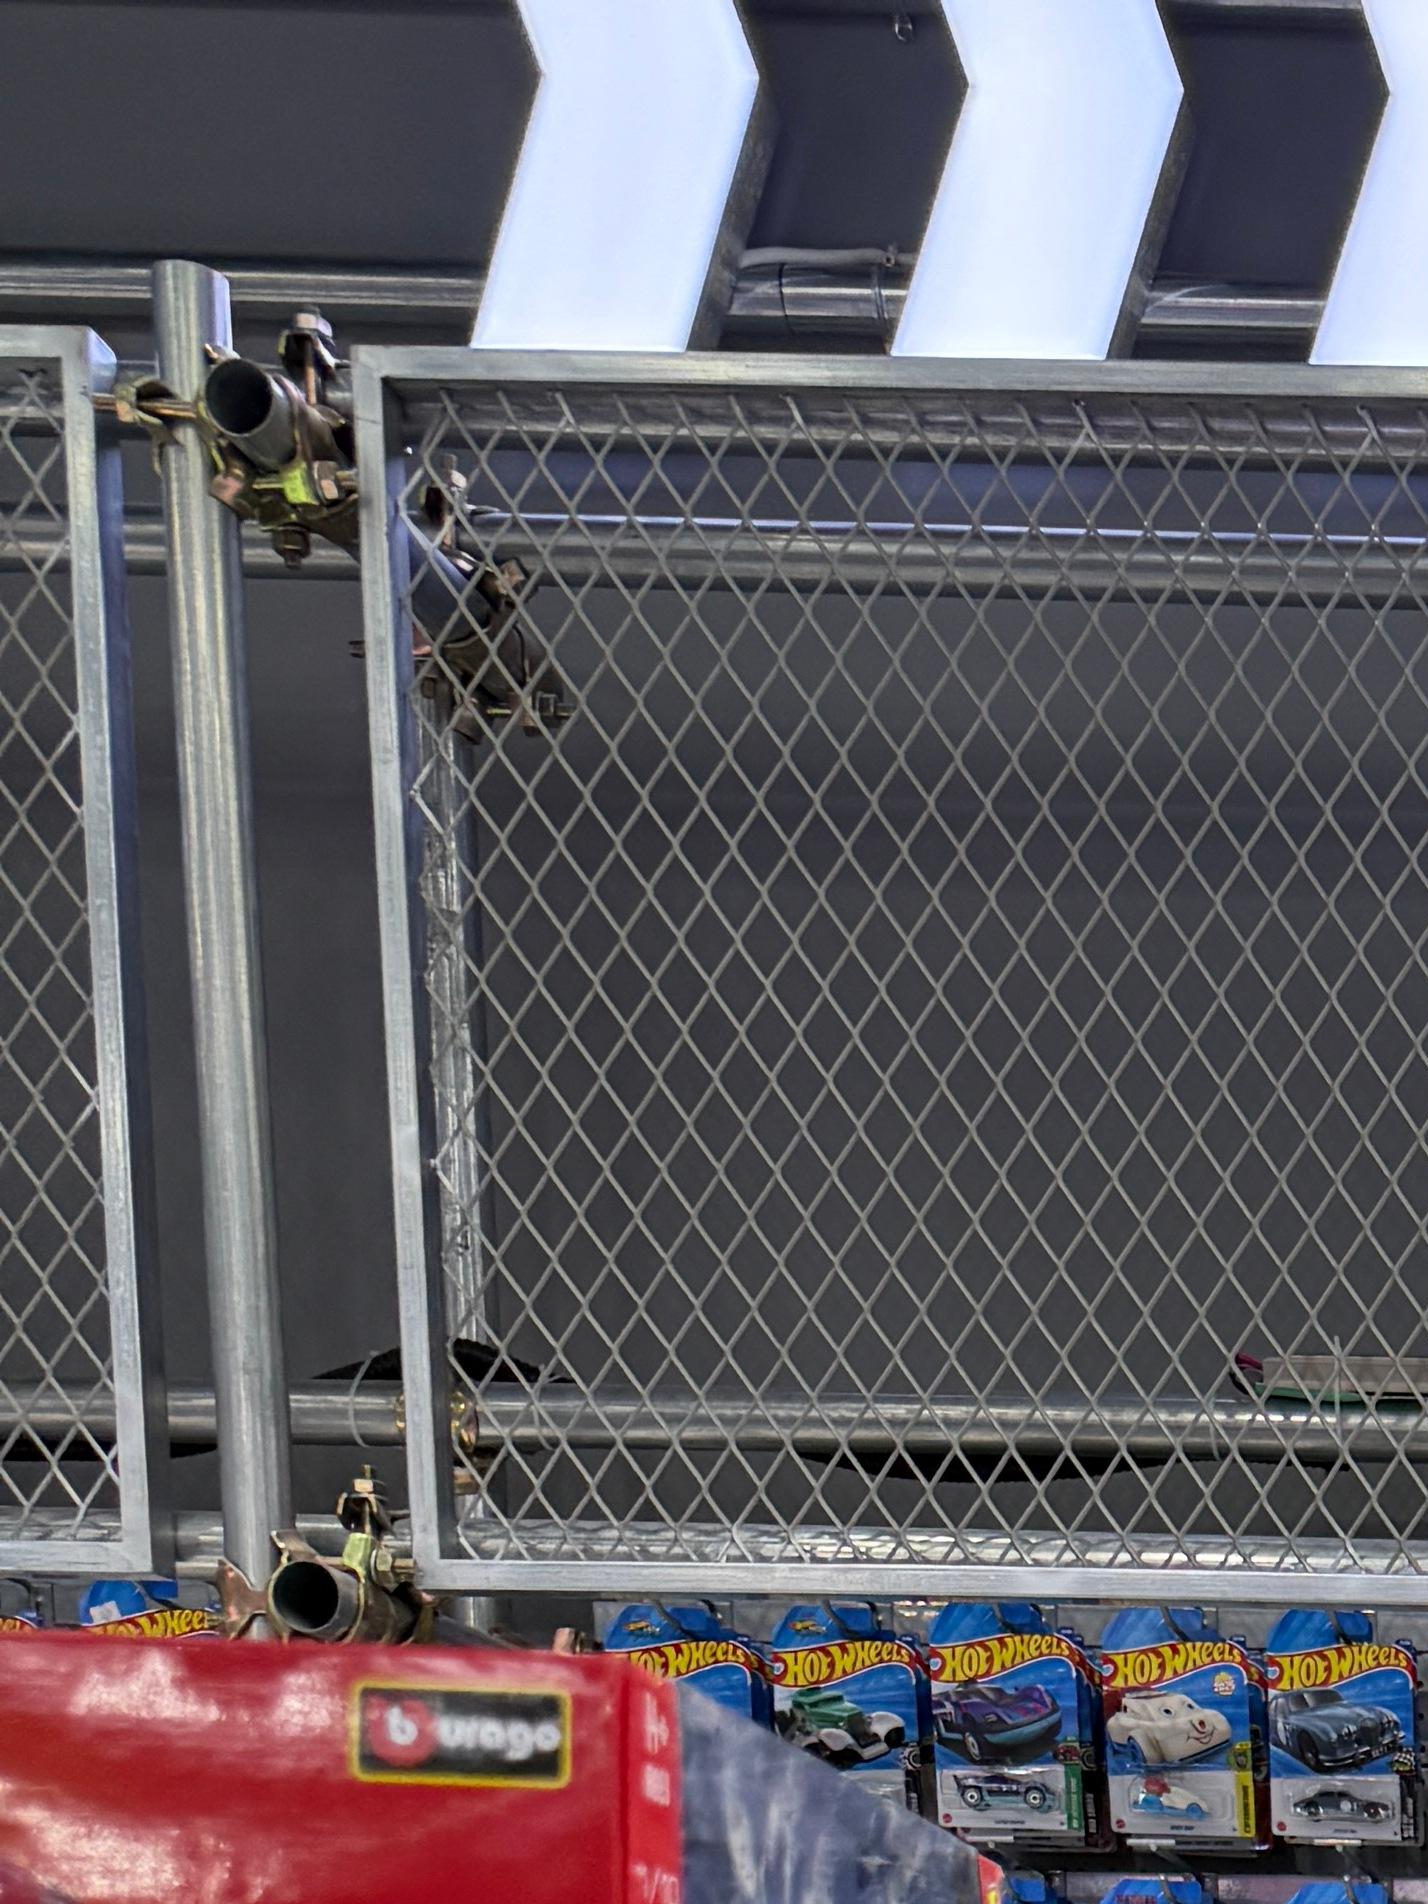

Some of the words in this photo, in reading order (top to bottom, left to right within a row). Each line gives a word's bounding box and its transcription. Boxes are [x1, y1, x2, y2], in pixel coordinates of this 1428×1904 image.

[783, 1646, 843, 1686] HOT
[840, 1642, 908, 1675] WHEELS
[1278, 1650, 1338, 1690] HOT
[1335, 1645, 1405, 1681] WHEELS
[381, 1706, 562, 1765] burago
